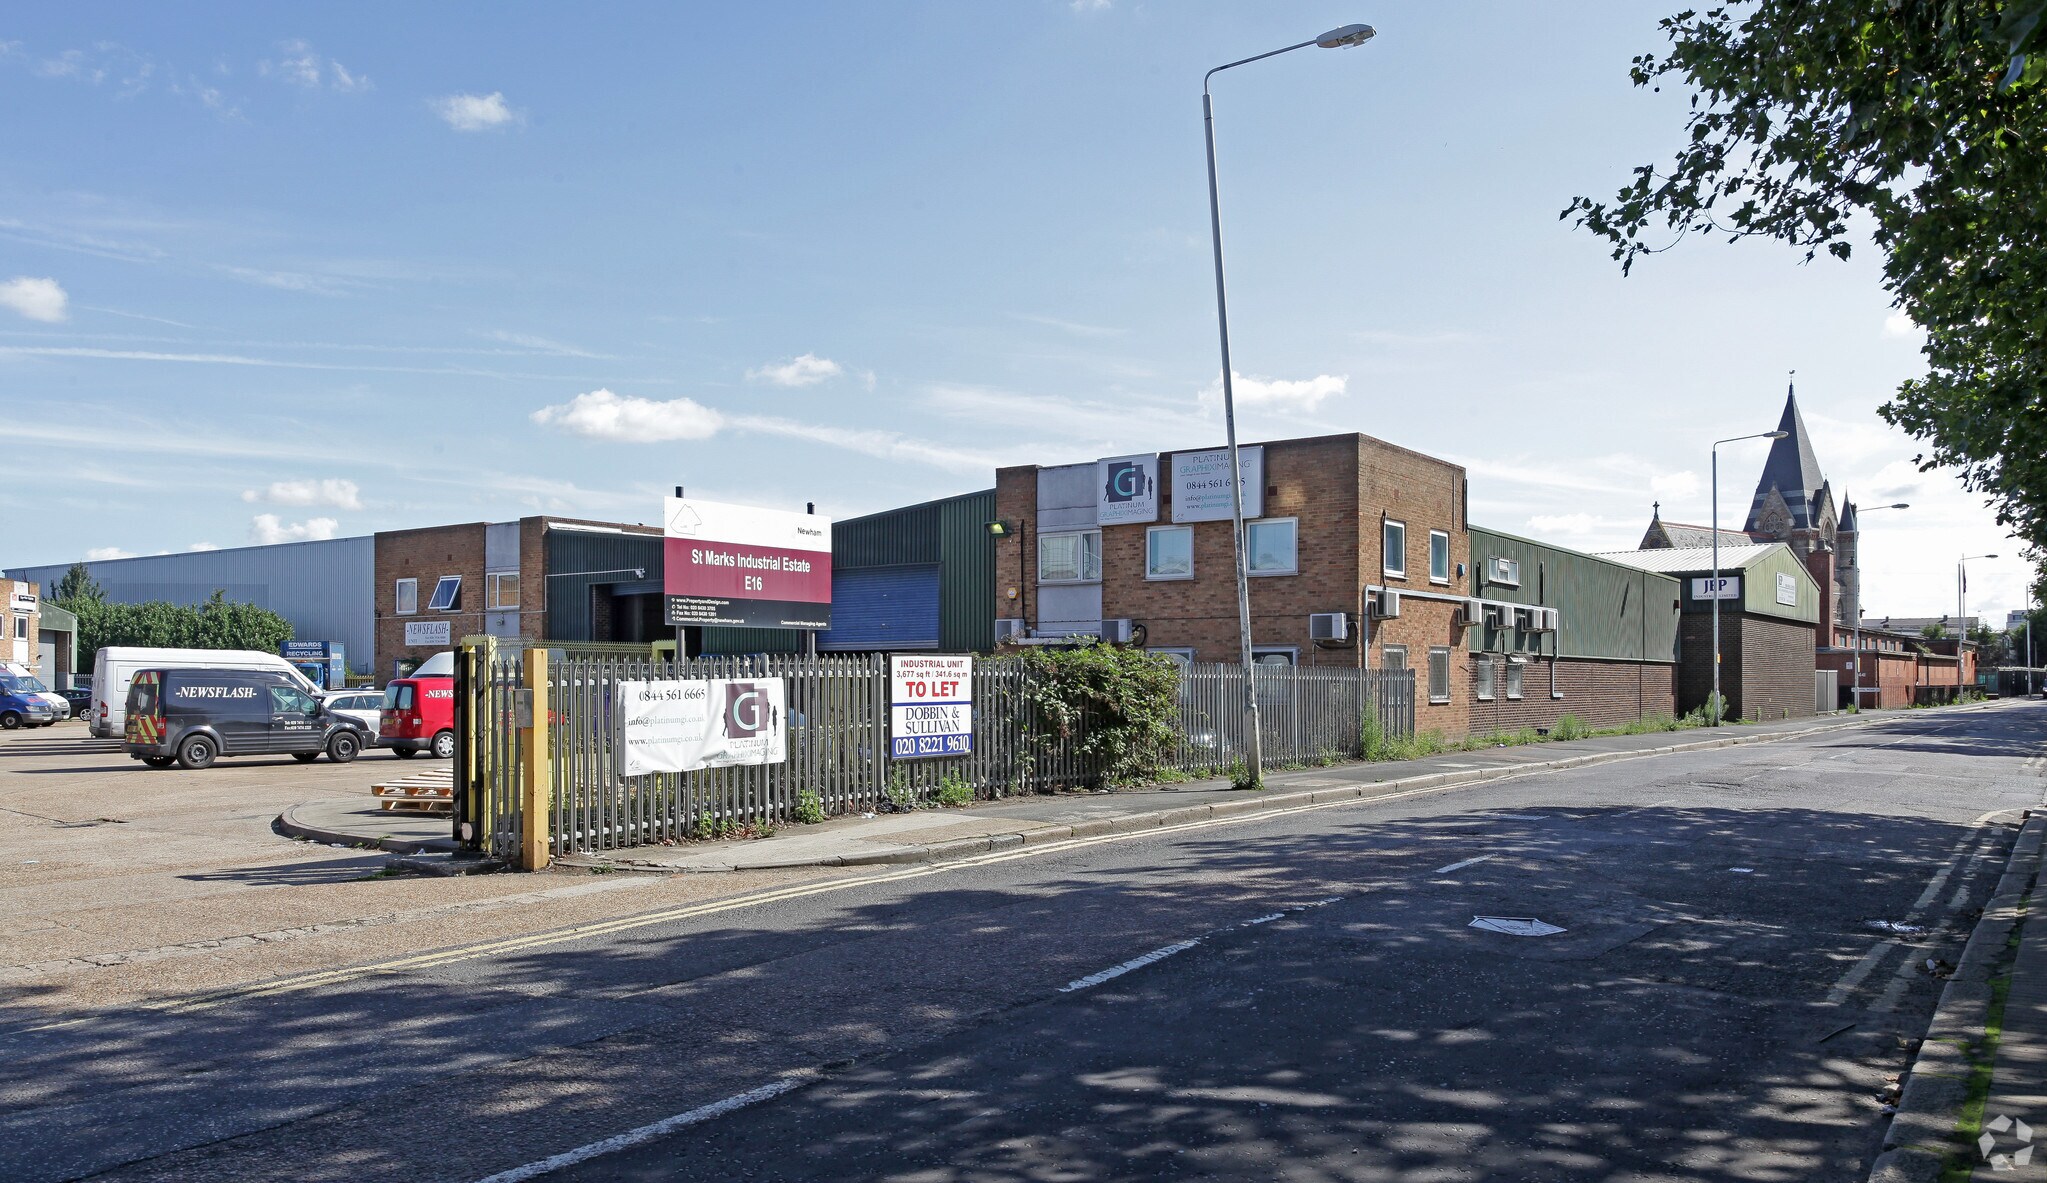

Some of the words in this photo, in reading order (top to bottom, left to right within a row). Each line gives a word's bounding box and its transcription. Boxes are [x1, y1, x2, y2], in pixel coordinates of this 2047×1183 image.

[1193, 453, 1230, 464] PLATINU
[1114, 467, 1136, 497] G
[1186, 480, 1207, 490] 0844
[1208, 478, 1222, 489] 561
[1225, 477, 1246, 487] 65
[1109, 501, 1145, 510] PLATINUM
[797, 527, 822, 537] Newham
[691, 548, 703, 564] St
[705, 550, 735, 567] Marks
[737, 552, 780, 571] Industrial
[782, 557, 811, 573] Estate
[744, 575, 763, 591] E16
[900, 660, 945, 668] INDUSTRIAL
[947, 660, 964, 668] UNIT
[896, 670, 915, 679] 3,677
[925, 670, 931, 678] ft
[935, 670, 952, 678] 341.6
[639, 690, 664, 702] 0844
[666, 689, 682, 701] 561
[684, 688, 706, 700] 6665
[905, 681, 927, 698] TO
[931, 681, 959, 697] LET
[733, 691, 760, 731] G
[905, 706, 948, 721] DOBBIN
[952, 706, 960, 719] &
[628, 713, 706, 728] info@platinumgi.co.uk
[905, 719, 960, 735] SULLIVAN
[628, 733, 704, 747] www.platinumgi.co.uk
[730, 739, 769, 749] PLATINUM
[895, 737, 916, 755] 020
[919, 736, 944, 754] 8221
[946, 734, 970, 752] 9610
